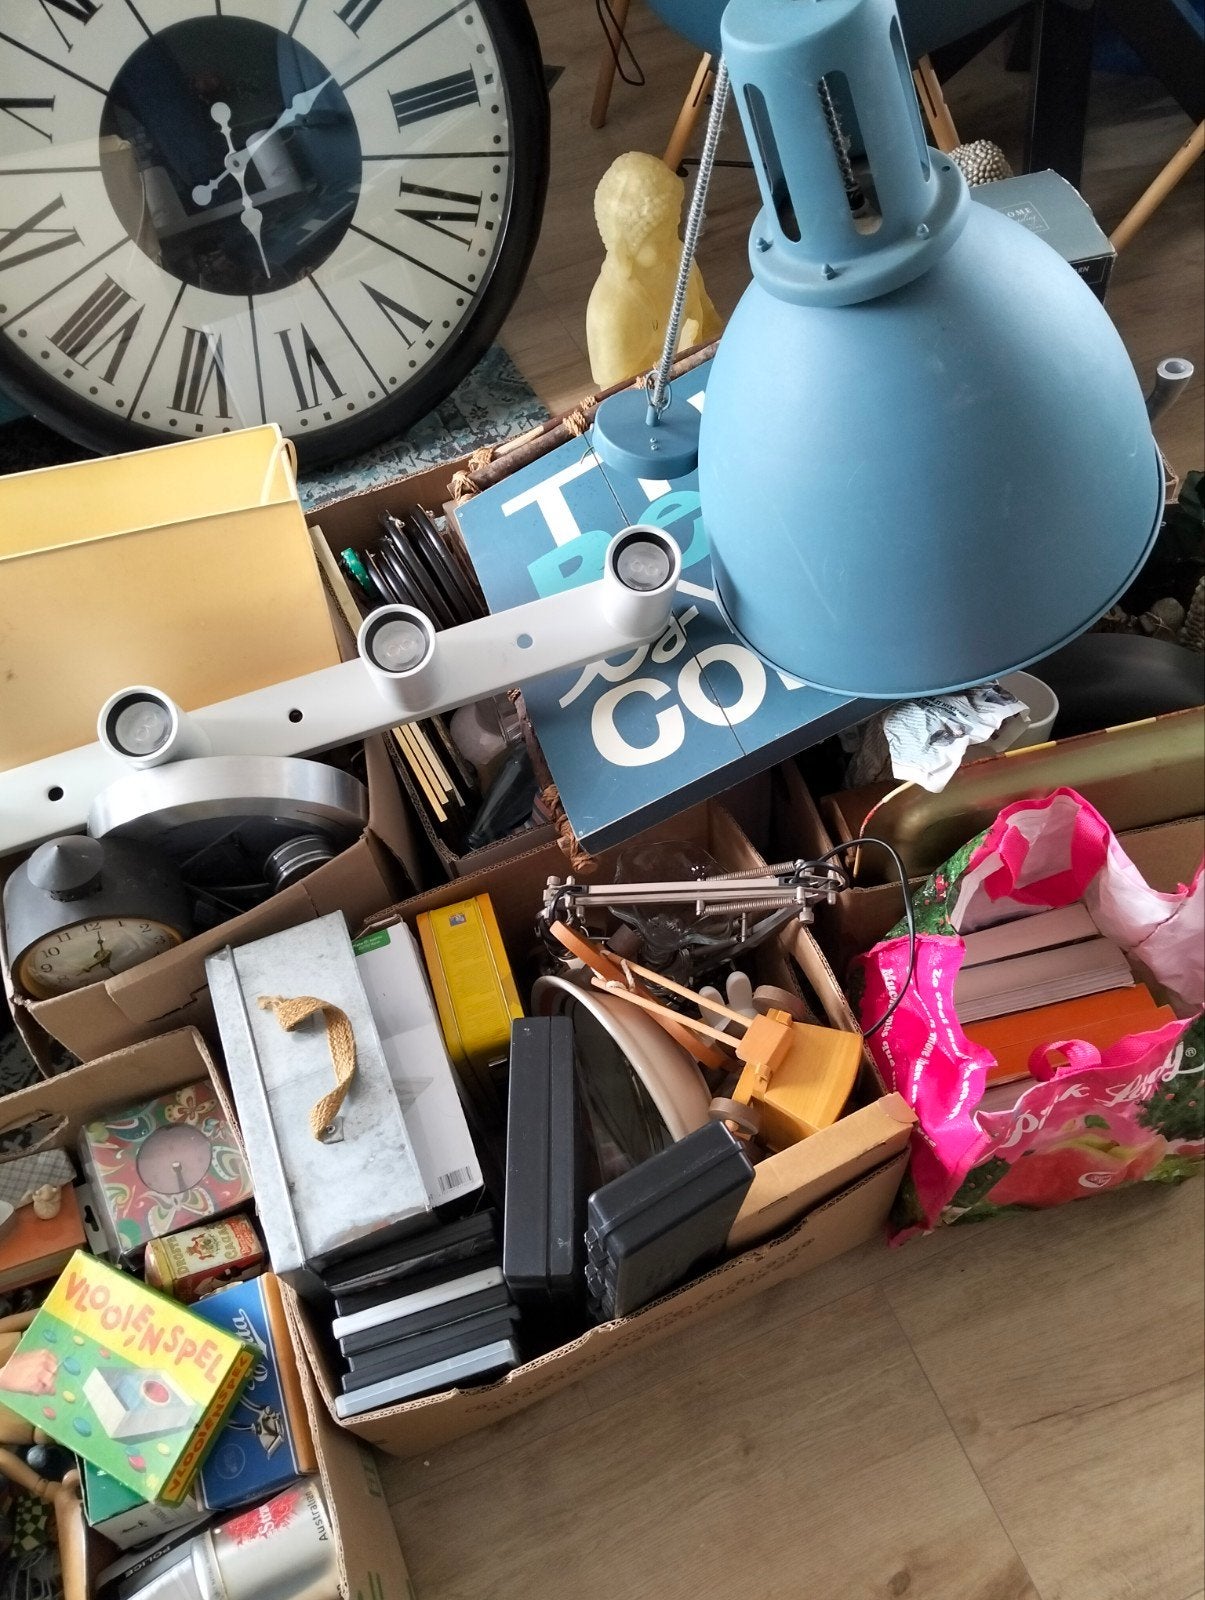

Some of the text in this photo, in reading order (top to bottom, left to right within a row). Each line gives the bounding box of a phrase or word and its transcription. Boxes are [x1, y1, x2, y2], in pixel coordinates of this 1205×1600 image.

[1007, 207, 1033, 218] OME
[83, 921, 101, 933] 12
[139, 924, 151, 933] 2
[56, 932, 72, 943] 11
[42, 946, 60, 959] 10
[41, 963, 53, 973] 9
[65, 1272, 224, 1383] VLOOIENSPEL
[168, 1356, 248, 1493] VLOOIENSPEL
[304, 1490, 329, 1542] Australian
[124, 1545, 171, 1579] POLICE
